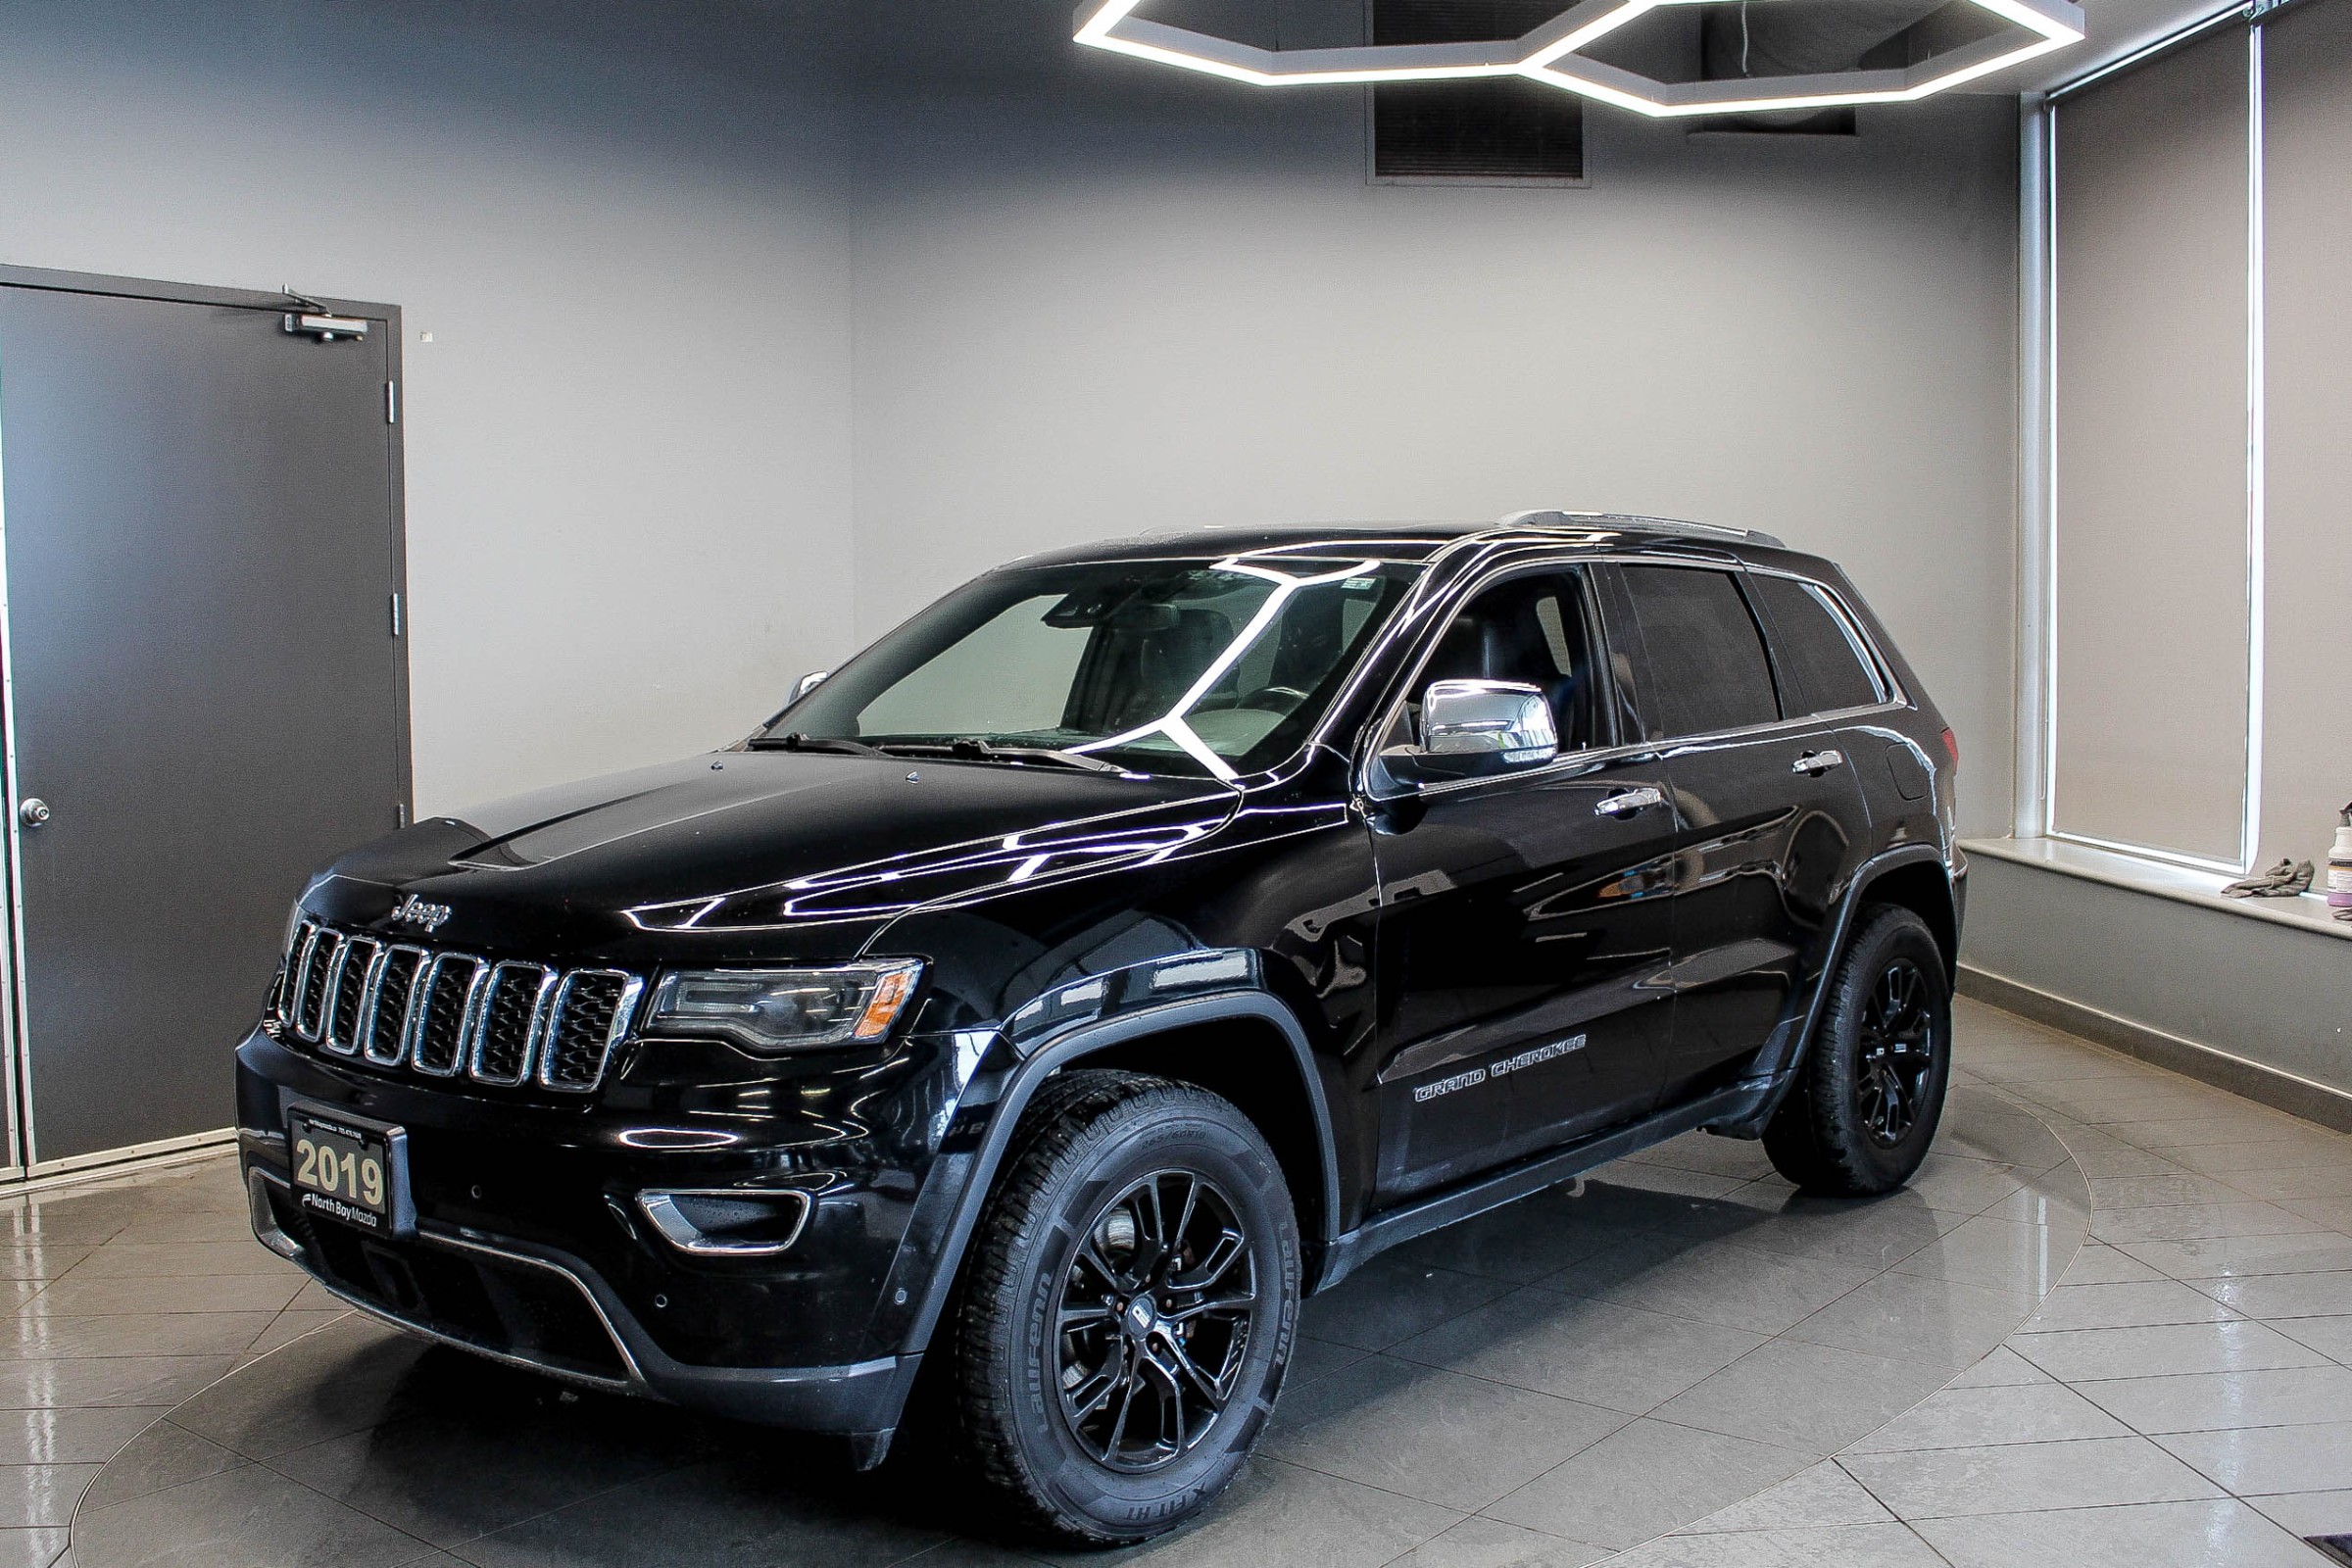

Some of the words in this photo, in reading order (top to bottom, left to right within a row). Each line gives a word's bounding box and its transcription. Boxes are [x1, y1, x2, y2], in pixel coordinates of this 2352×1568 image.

[391, 894, 452, 933] Jeep
[1414, 1068, 1487, 1102] GRAND
[1491, 1034, 1587, 1077] CHEROKEE
[296, 1139, 384, 1205] 2019
[312, 1193, 335, 1213] North
[335, 1201, 352, 1221] Bay
[352, 1206, 377, 1227] Mazda
